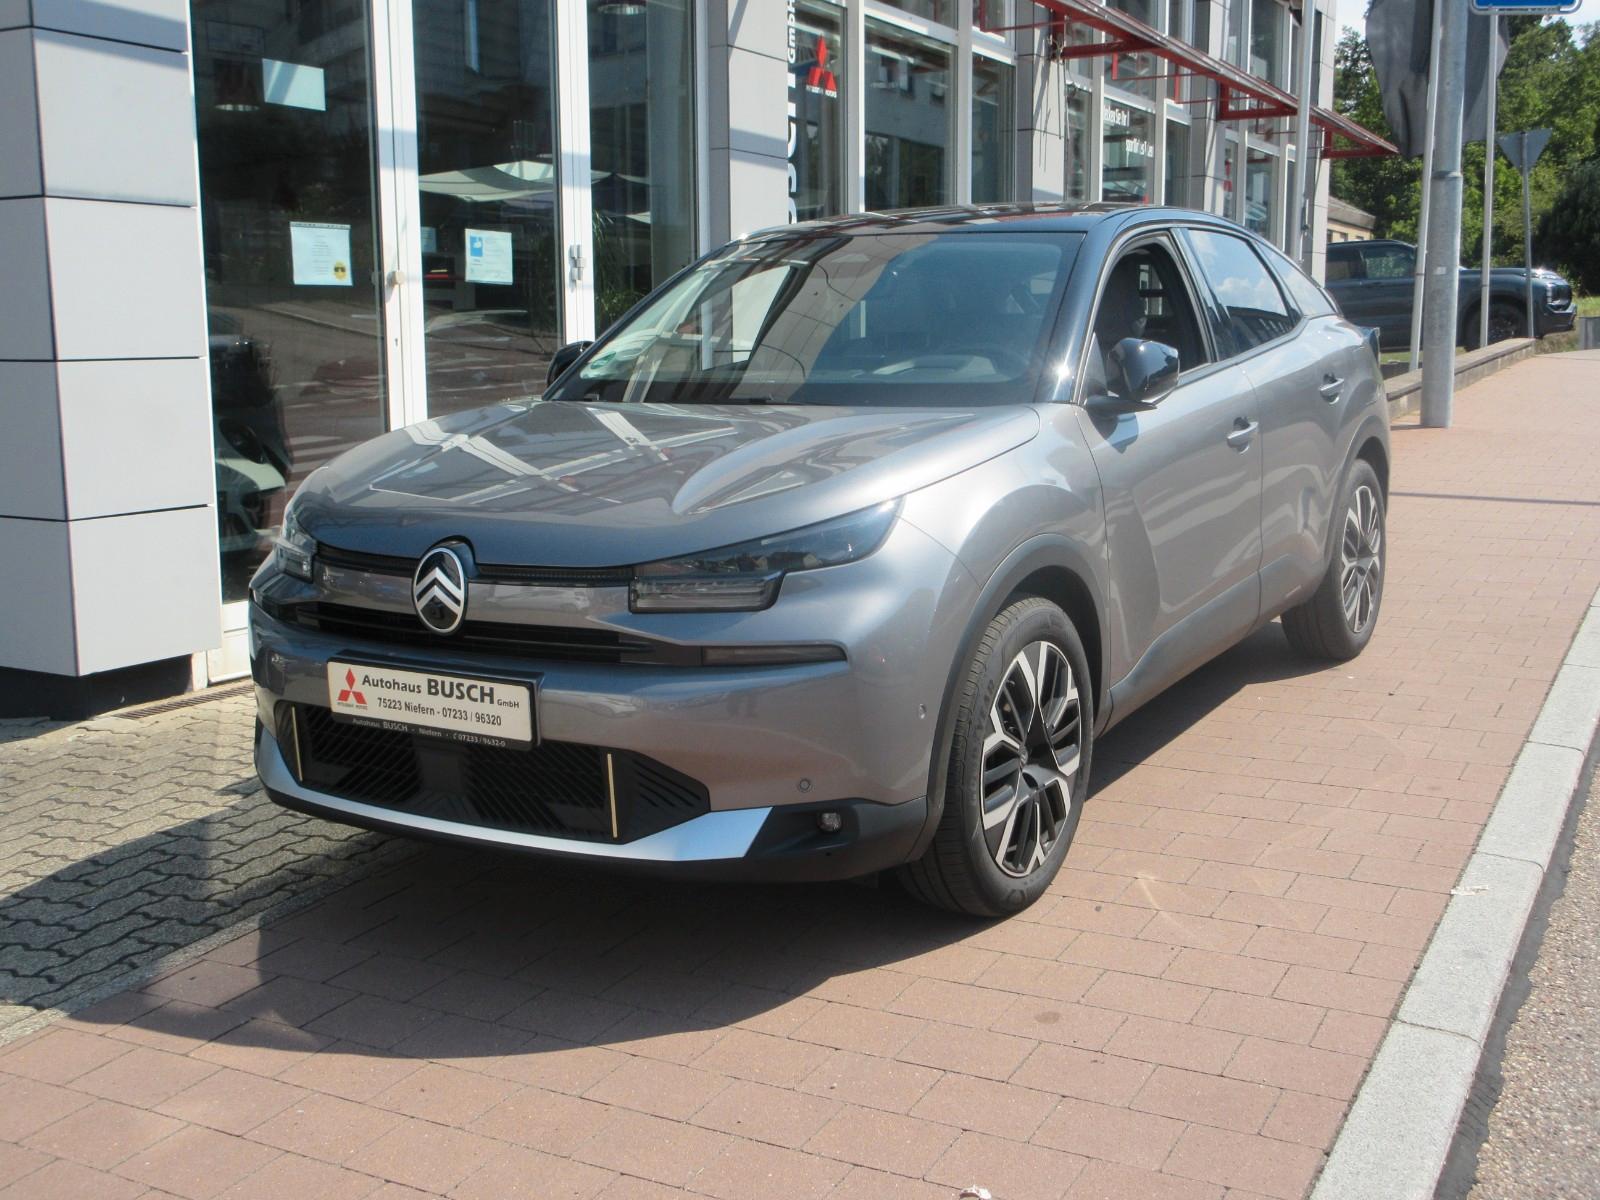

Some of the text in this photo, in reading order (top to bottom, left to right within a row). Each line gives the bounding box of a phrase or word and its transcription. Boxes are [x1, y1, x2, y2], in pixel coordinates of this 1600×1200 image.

[362, 674, 520, 709] Autohaus BUSCH GmbH
[377, 697, 403, 711] 75223
[404, 700, 435, 716] Niefern
[442, 706, 468, 721] 07233
[475, 711, 502, 726] 96320
[383, 721, 408, 732] BUSCH
